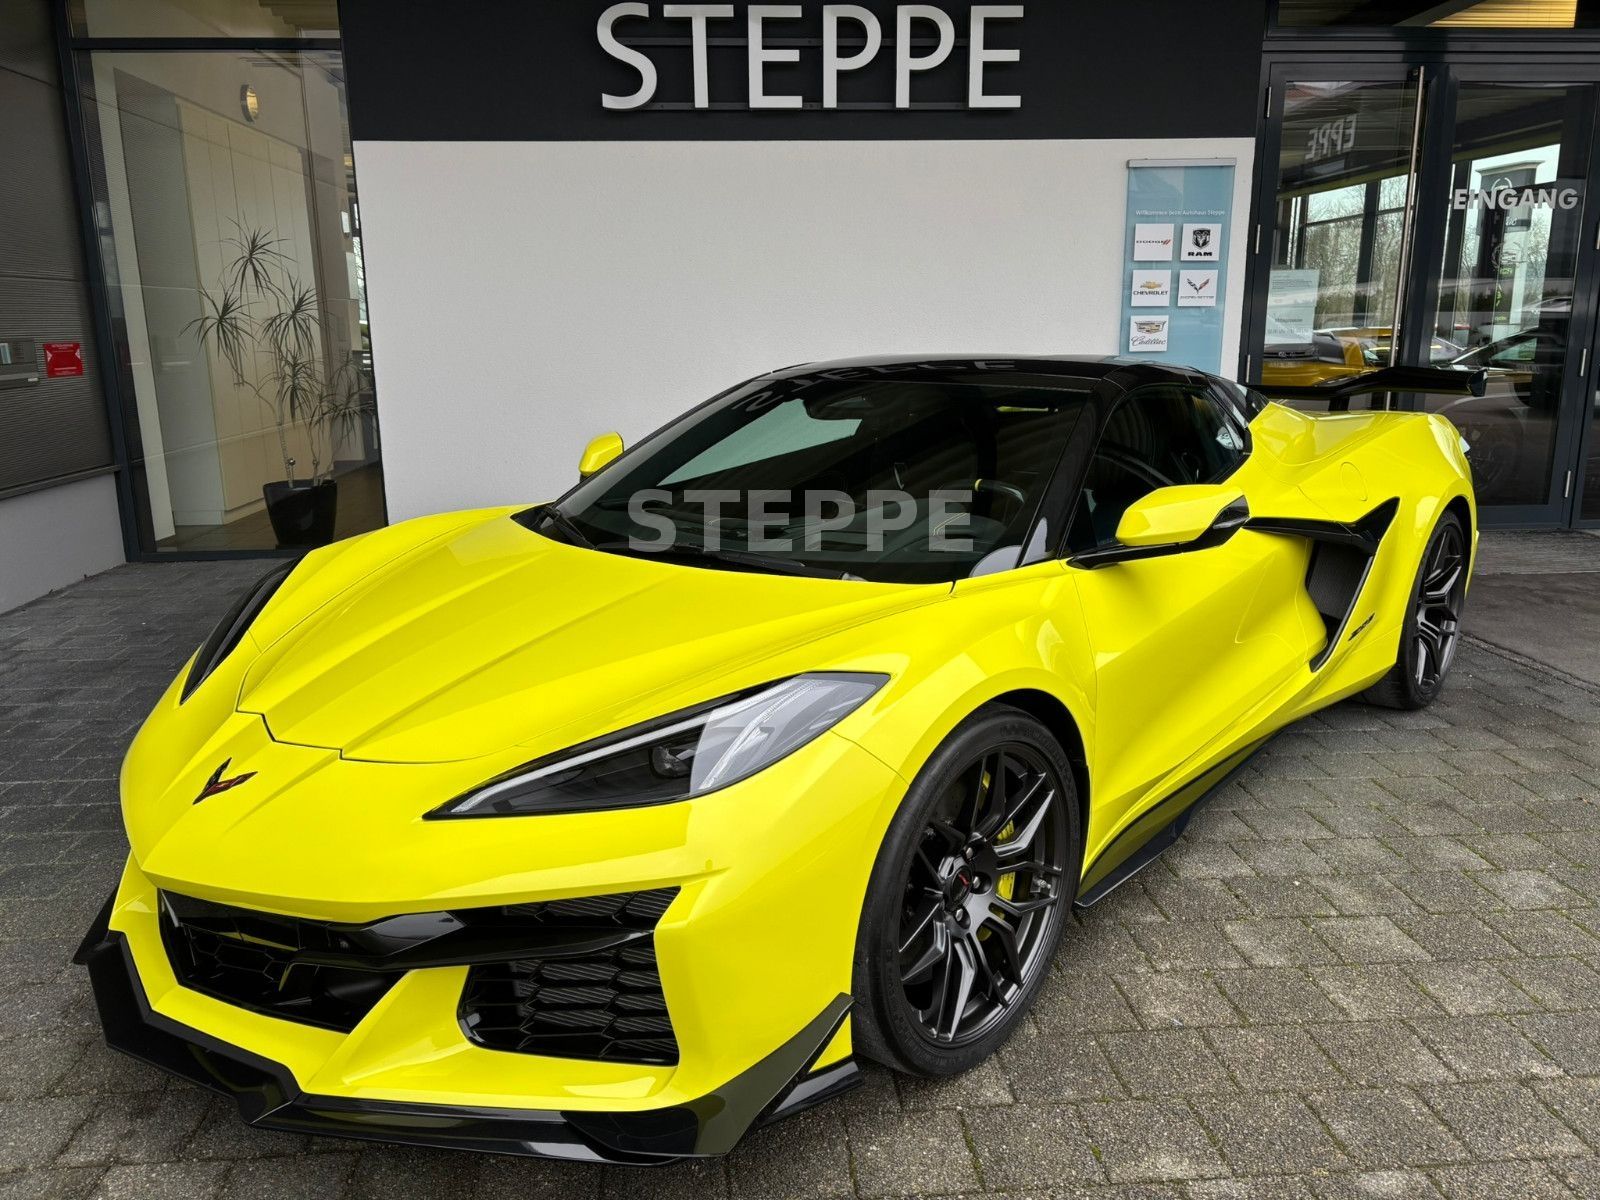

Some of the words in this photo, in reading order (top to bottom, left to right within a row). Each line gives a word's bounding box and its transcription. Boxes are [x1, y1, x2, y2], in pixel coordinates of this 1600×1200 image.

[597, 2, 1024, 109] STEPPE
[1454, 188, 1578, 210] EINGANG
[1131, 336, 1167, 346] Cadillac
